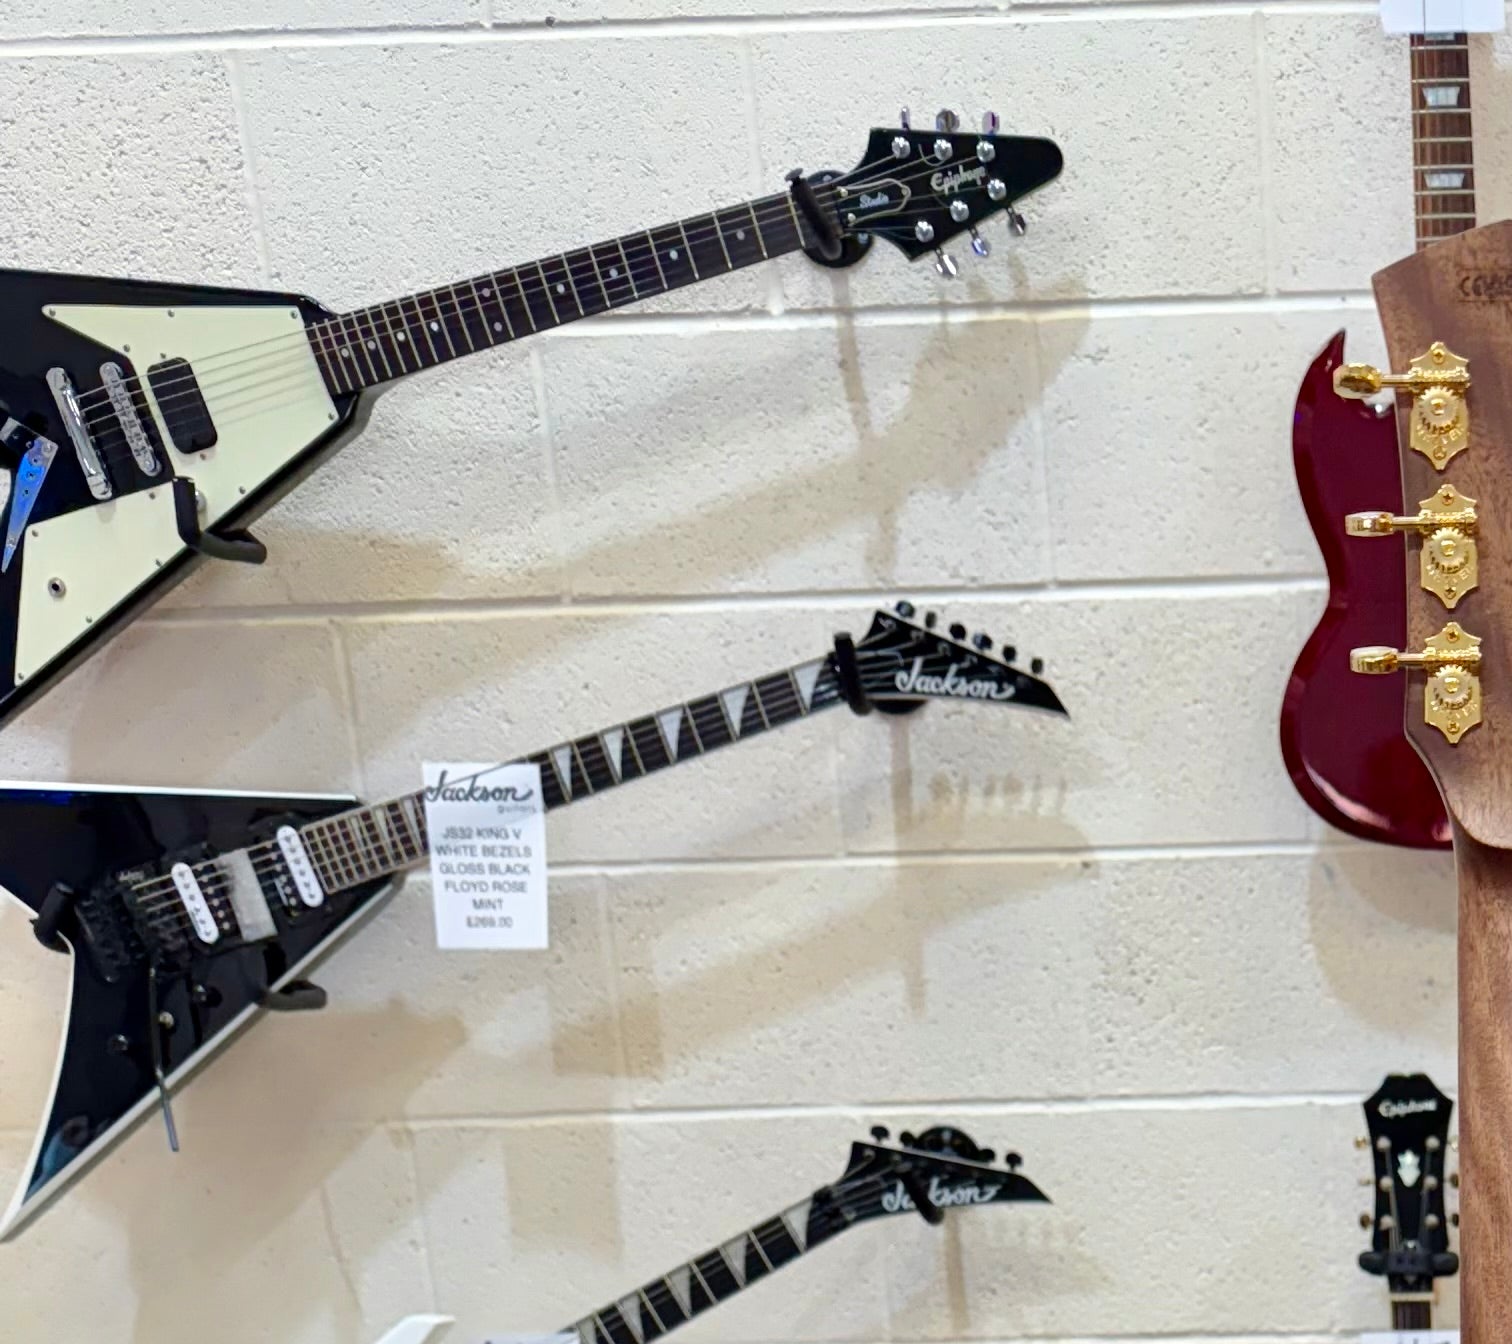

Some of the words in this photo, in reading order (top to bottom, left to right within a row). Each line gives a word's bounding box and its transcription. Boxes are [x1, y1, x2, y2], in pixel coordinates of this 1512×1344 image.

[895, 656, 1016, 700] Jackson
[423, 769, 533, 802] Jackson
[476, 827, 510, 840] KING
[512, 827, 522, 840] V
[435, 845, 477, 857] WHITE
[481, 845, 532, 857] BEZELS
[439, 863, 486, 875] GLOSS
[488, 863, 531, 875] BLACK
[444, 881, 488, 893] FLOYD
[492, 881, 528, 893] ROSE
[472, 899, 504, 910] MINT
